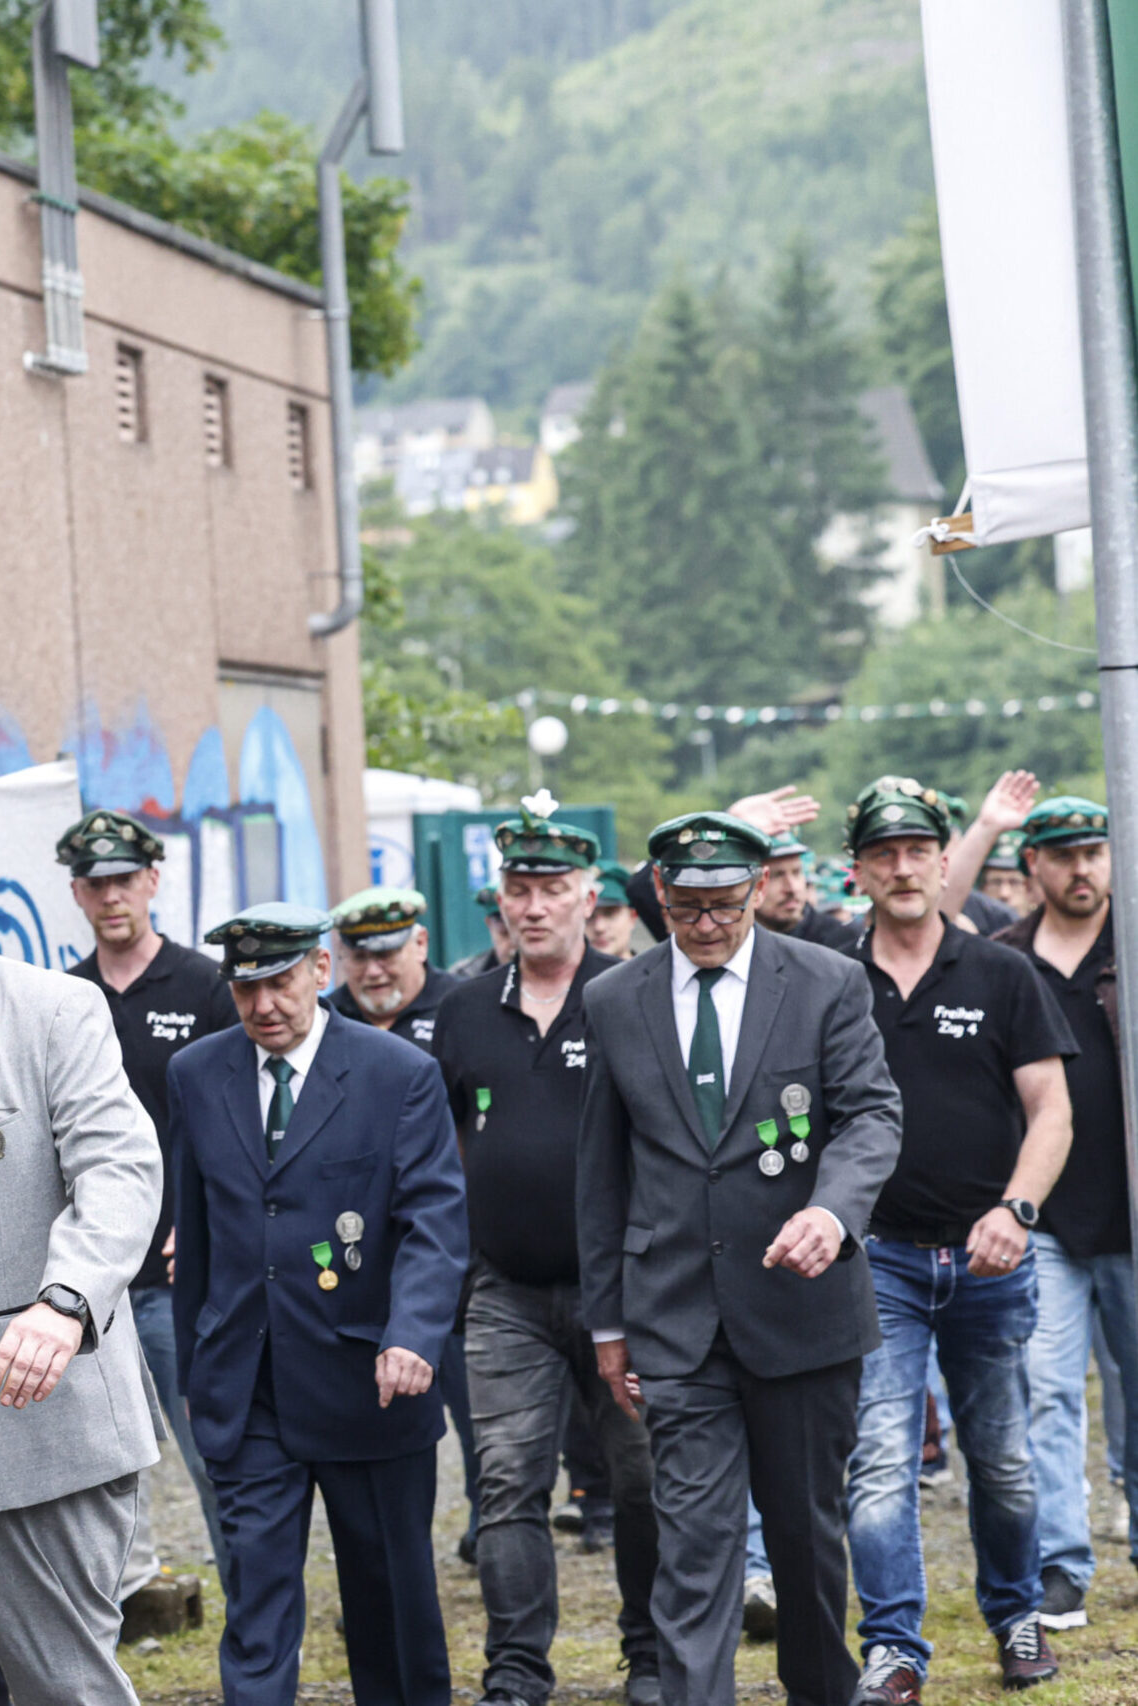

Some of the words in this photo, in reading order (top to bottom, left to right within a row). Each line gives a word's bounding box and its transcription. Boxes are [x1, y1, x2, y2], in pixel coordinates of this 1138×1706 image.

[146, 1011, 196, 1026] Freiheit
[933, 1005, 985, 1021] Freiheit
[152, 1024, 178, 1041] Zug
[179, 1025, 190, 1039] 4
[937, 1020, 965, 1039] Zug
[966, 1022, 978, 1037] 4
[561, 1038, 586, 1054] Frei
